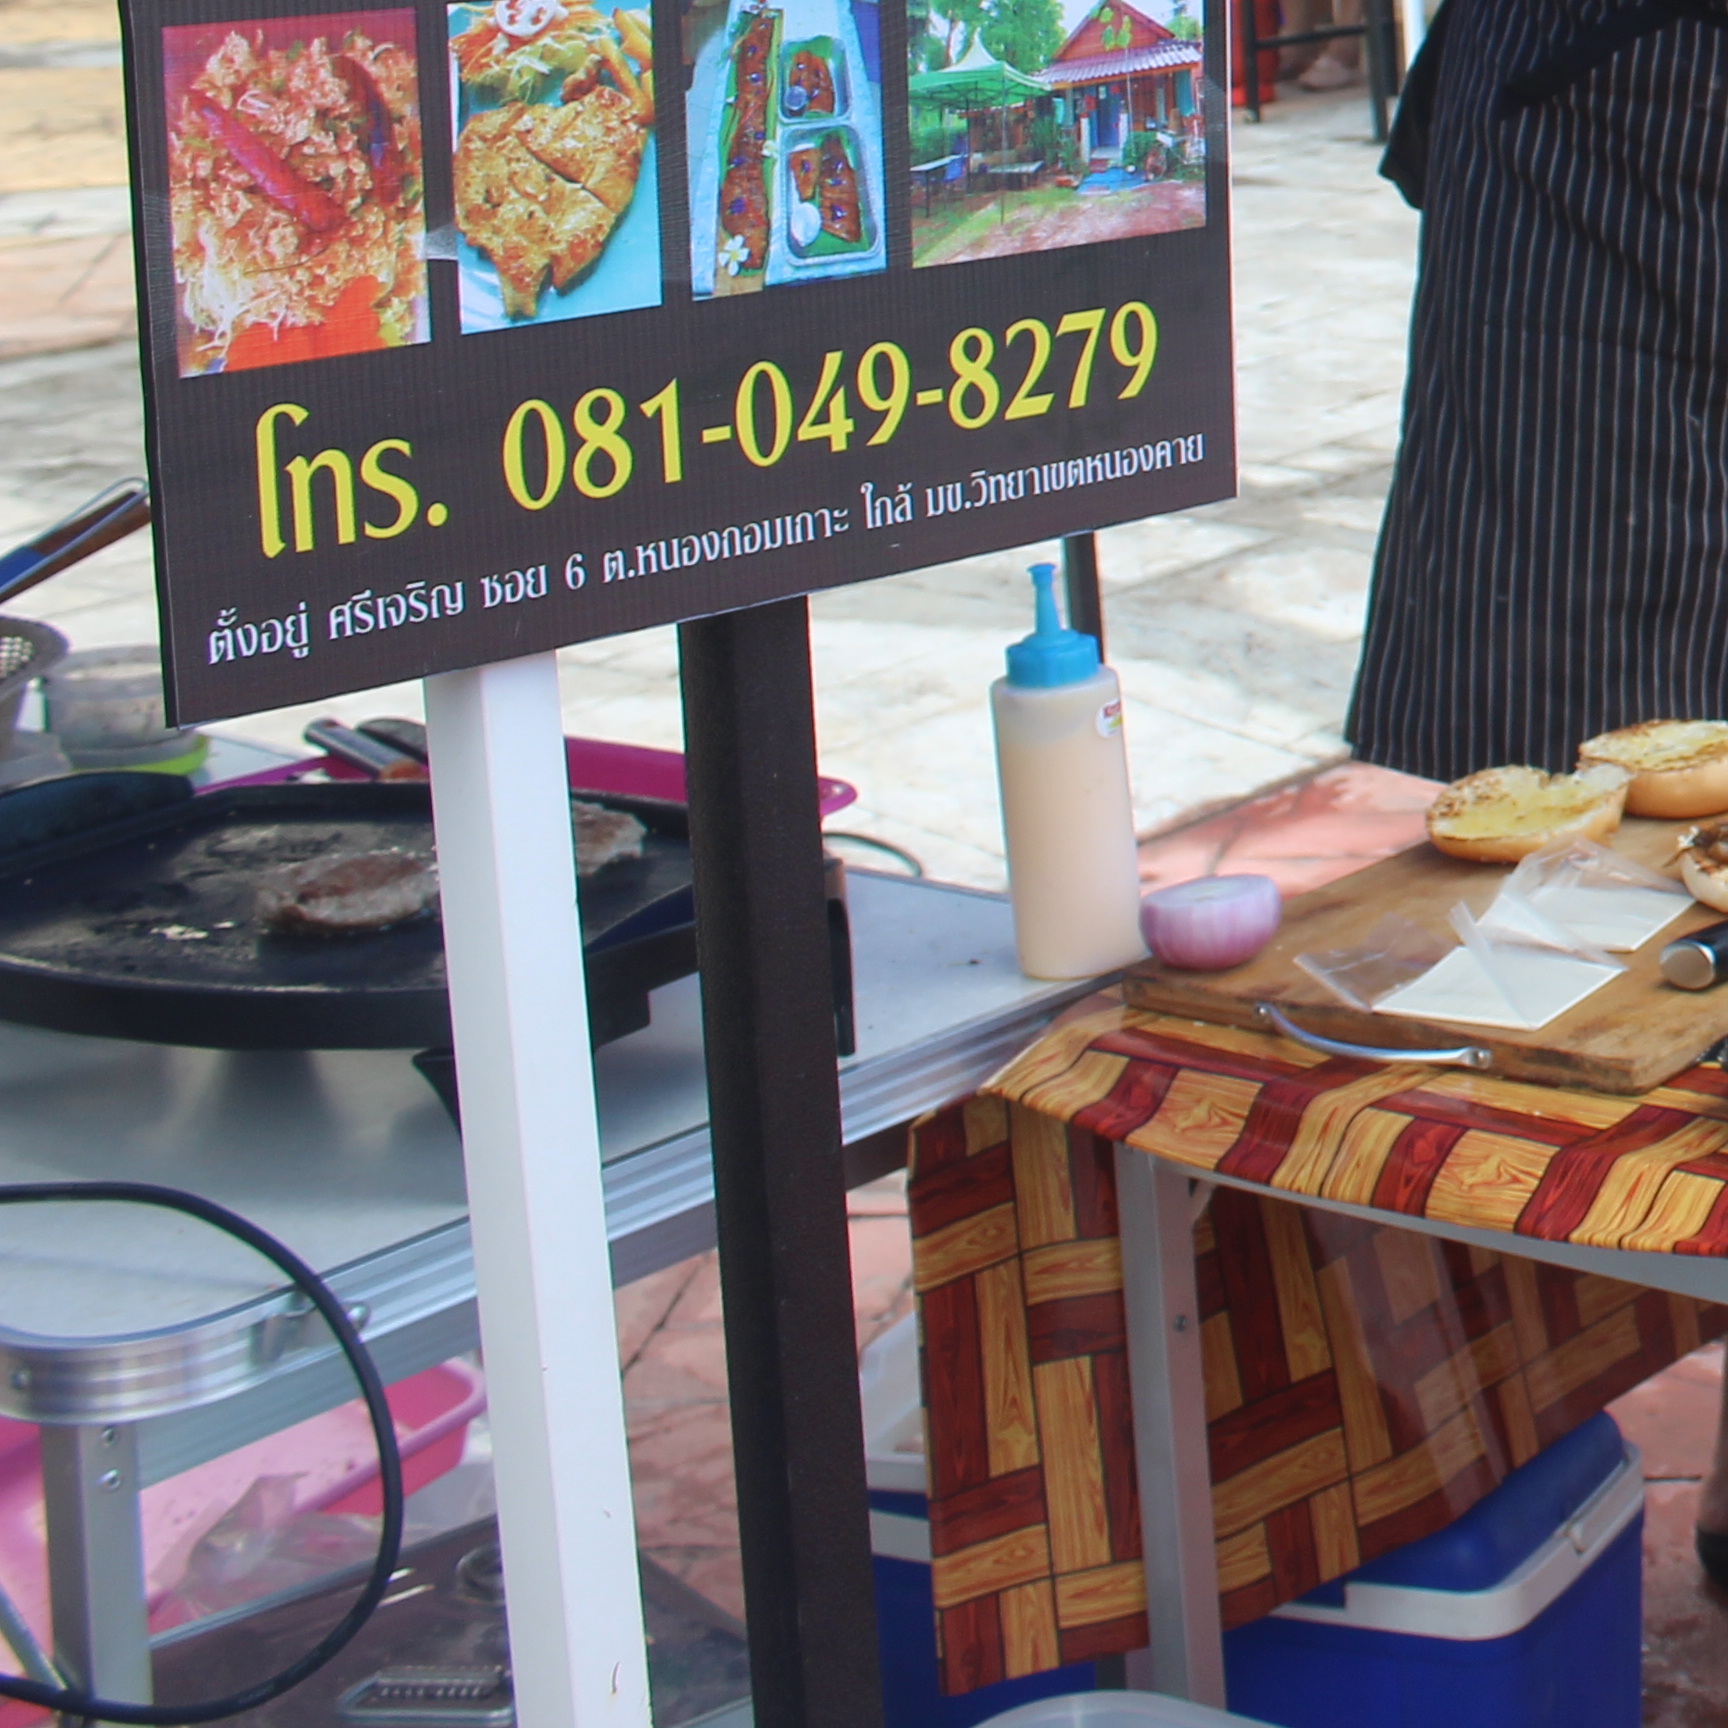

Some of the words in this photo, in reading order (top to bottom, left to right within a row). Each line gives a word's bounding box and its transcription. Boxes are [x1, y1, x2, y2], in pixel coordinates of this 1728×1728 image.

[208, 600, 311, 666] ตั้งอยู่
[329, 580, 464, 641] ศรีเจริญ
[480, 563, 548, 610] ซอย
[563, 552, 588, 591] 6
[602, 507, 850, 585] ต.หนองกอมเกาะ
[860, 482, 914, 530] ใกล้
[925, 432, 1205, 518] มข.วิทยาเขตหนองคาย
[255, 401, 449, 559] โทร.
[502, 300, 1159, 511] 081-049-8279
